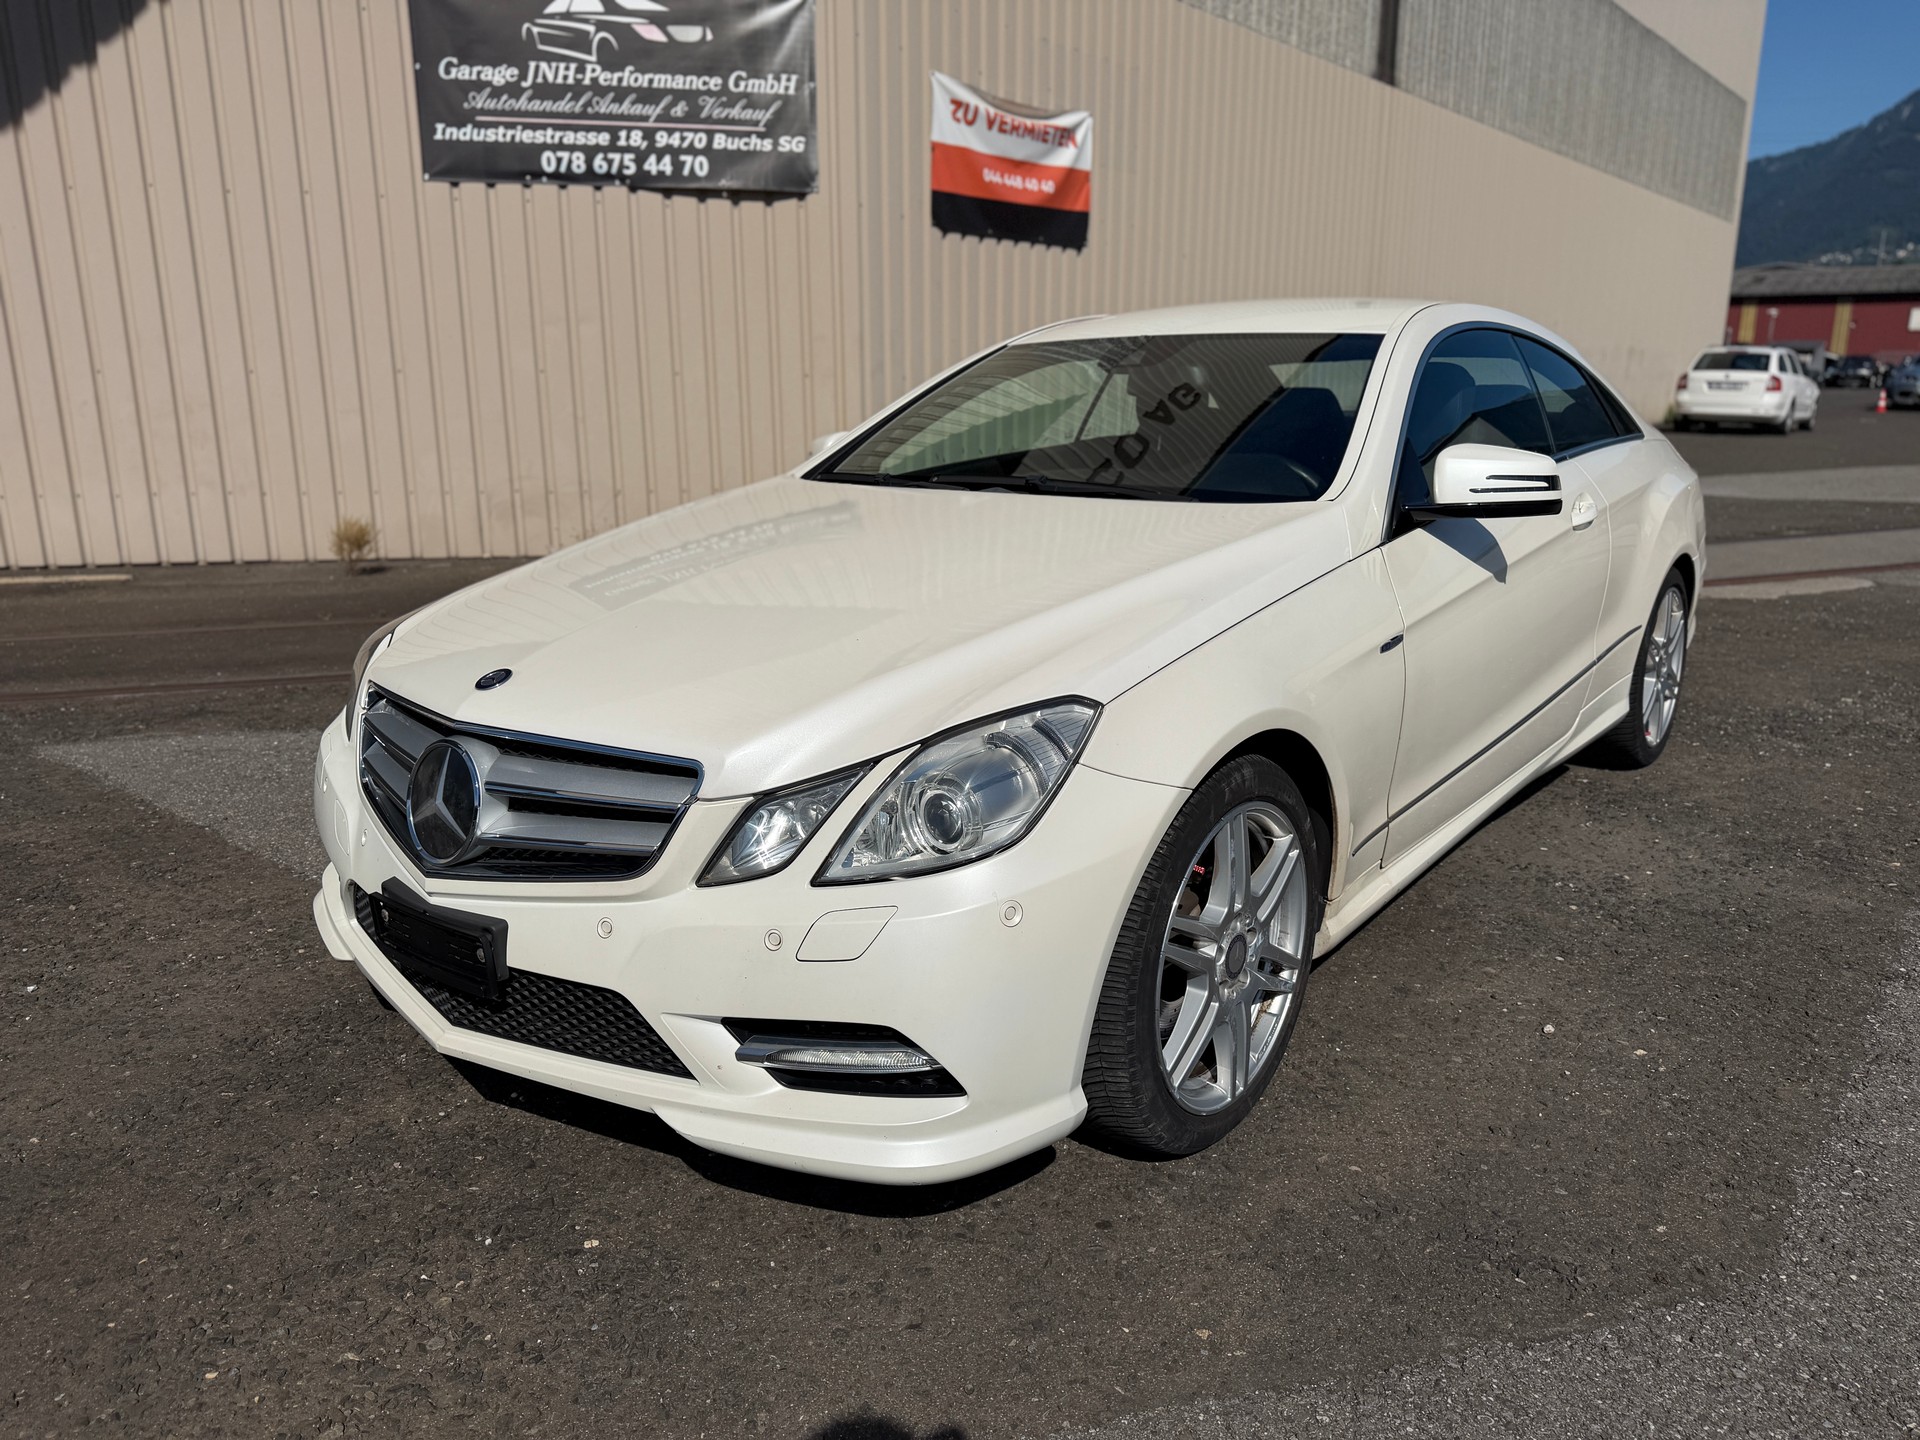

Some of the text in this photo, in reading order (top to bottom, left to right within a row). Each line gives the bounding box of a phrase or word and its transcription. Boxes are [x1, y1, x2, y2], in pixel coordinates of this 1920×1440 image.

[438, 56, 799, 95] Garage JNH-Performance GmbH
[463, 86, 783, 127] Autohandel Ankauf & Verkauf
[950, 98, 980, 126] ZU
[433, 122, 806, 153] Industriestrasse 18, 9470 Buchs SG
[540, 150, 710, 177] 078 675 44 70
